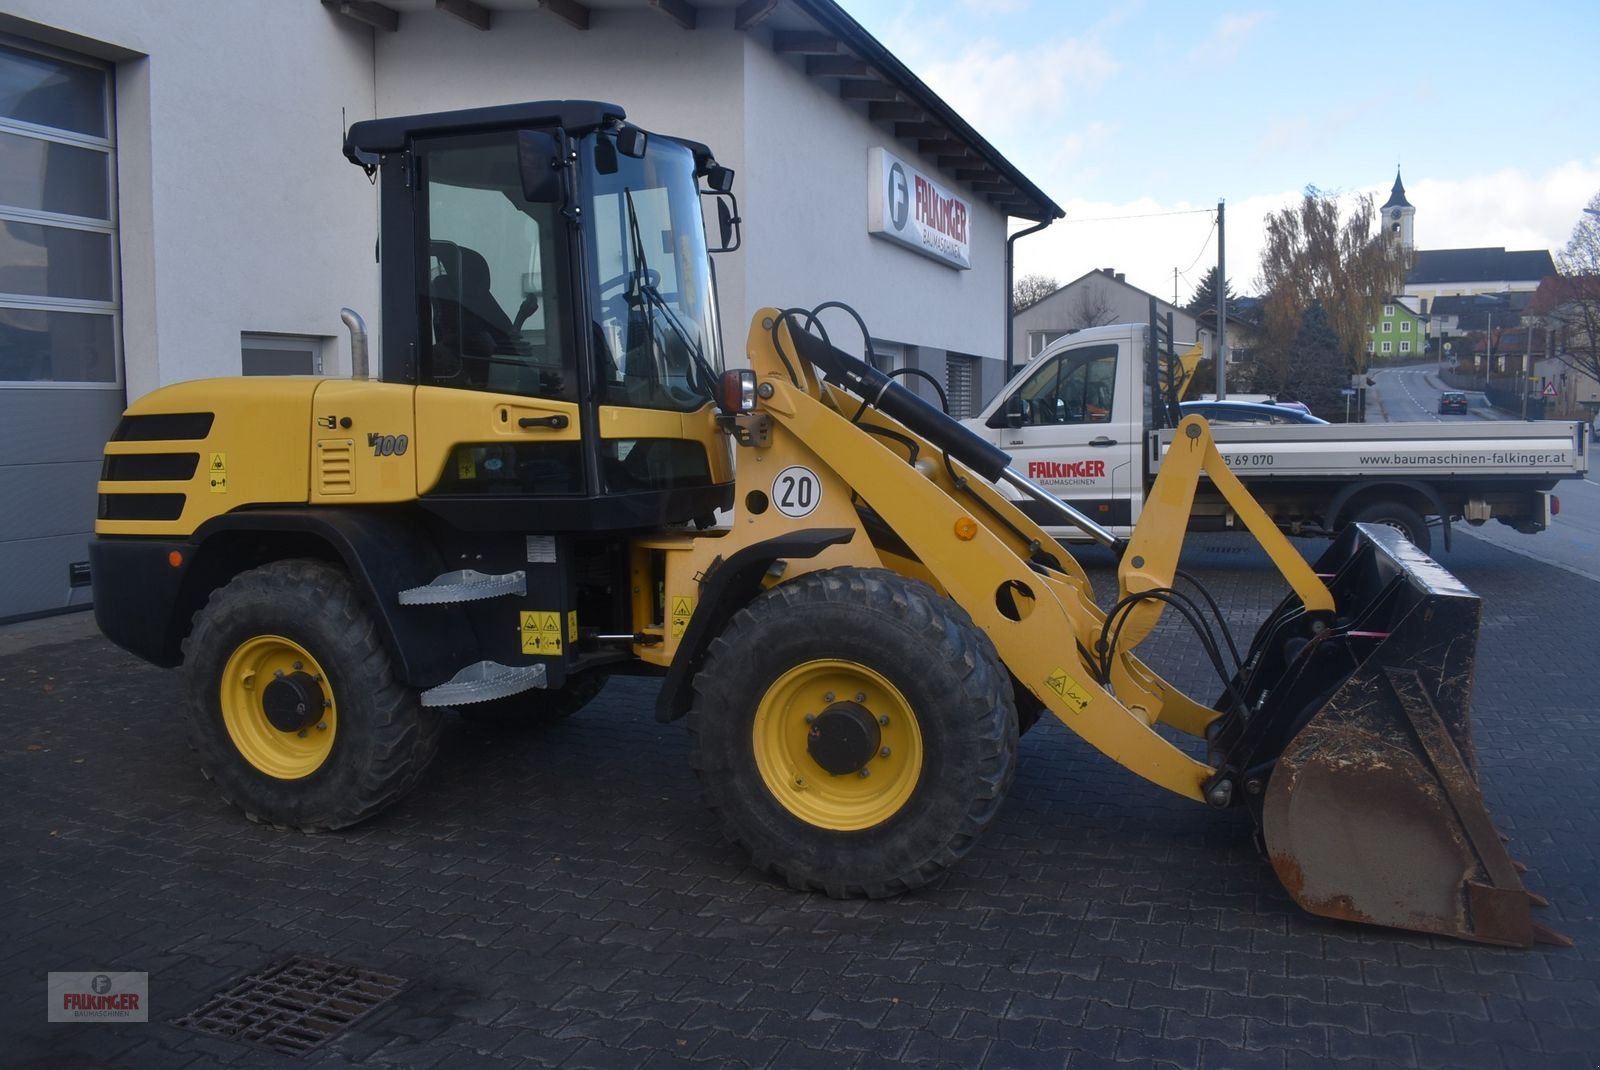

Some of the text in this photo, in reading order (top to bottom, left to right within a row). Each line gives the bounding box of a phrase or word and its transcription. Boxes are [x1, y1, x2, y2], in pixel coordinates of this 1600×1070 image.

[914, 174, 967, 245] FALKINGER
[1221, 454, 1274, 466] 5 69 070
[1359, 452, 1567, 466] www.baumaschinen-falkinger.at
[1028, 460, 1105, 479] FALKINGER
[780, 475, 812, 508] 20
